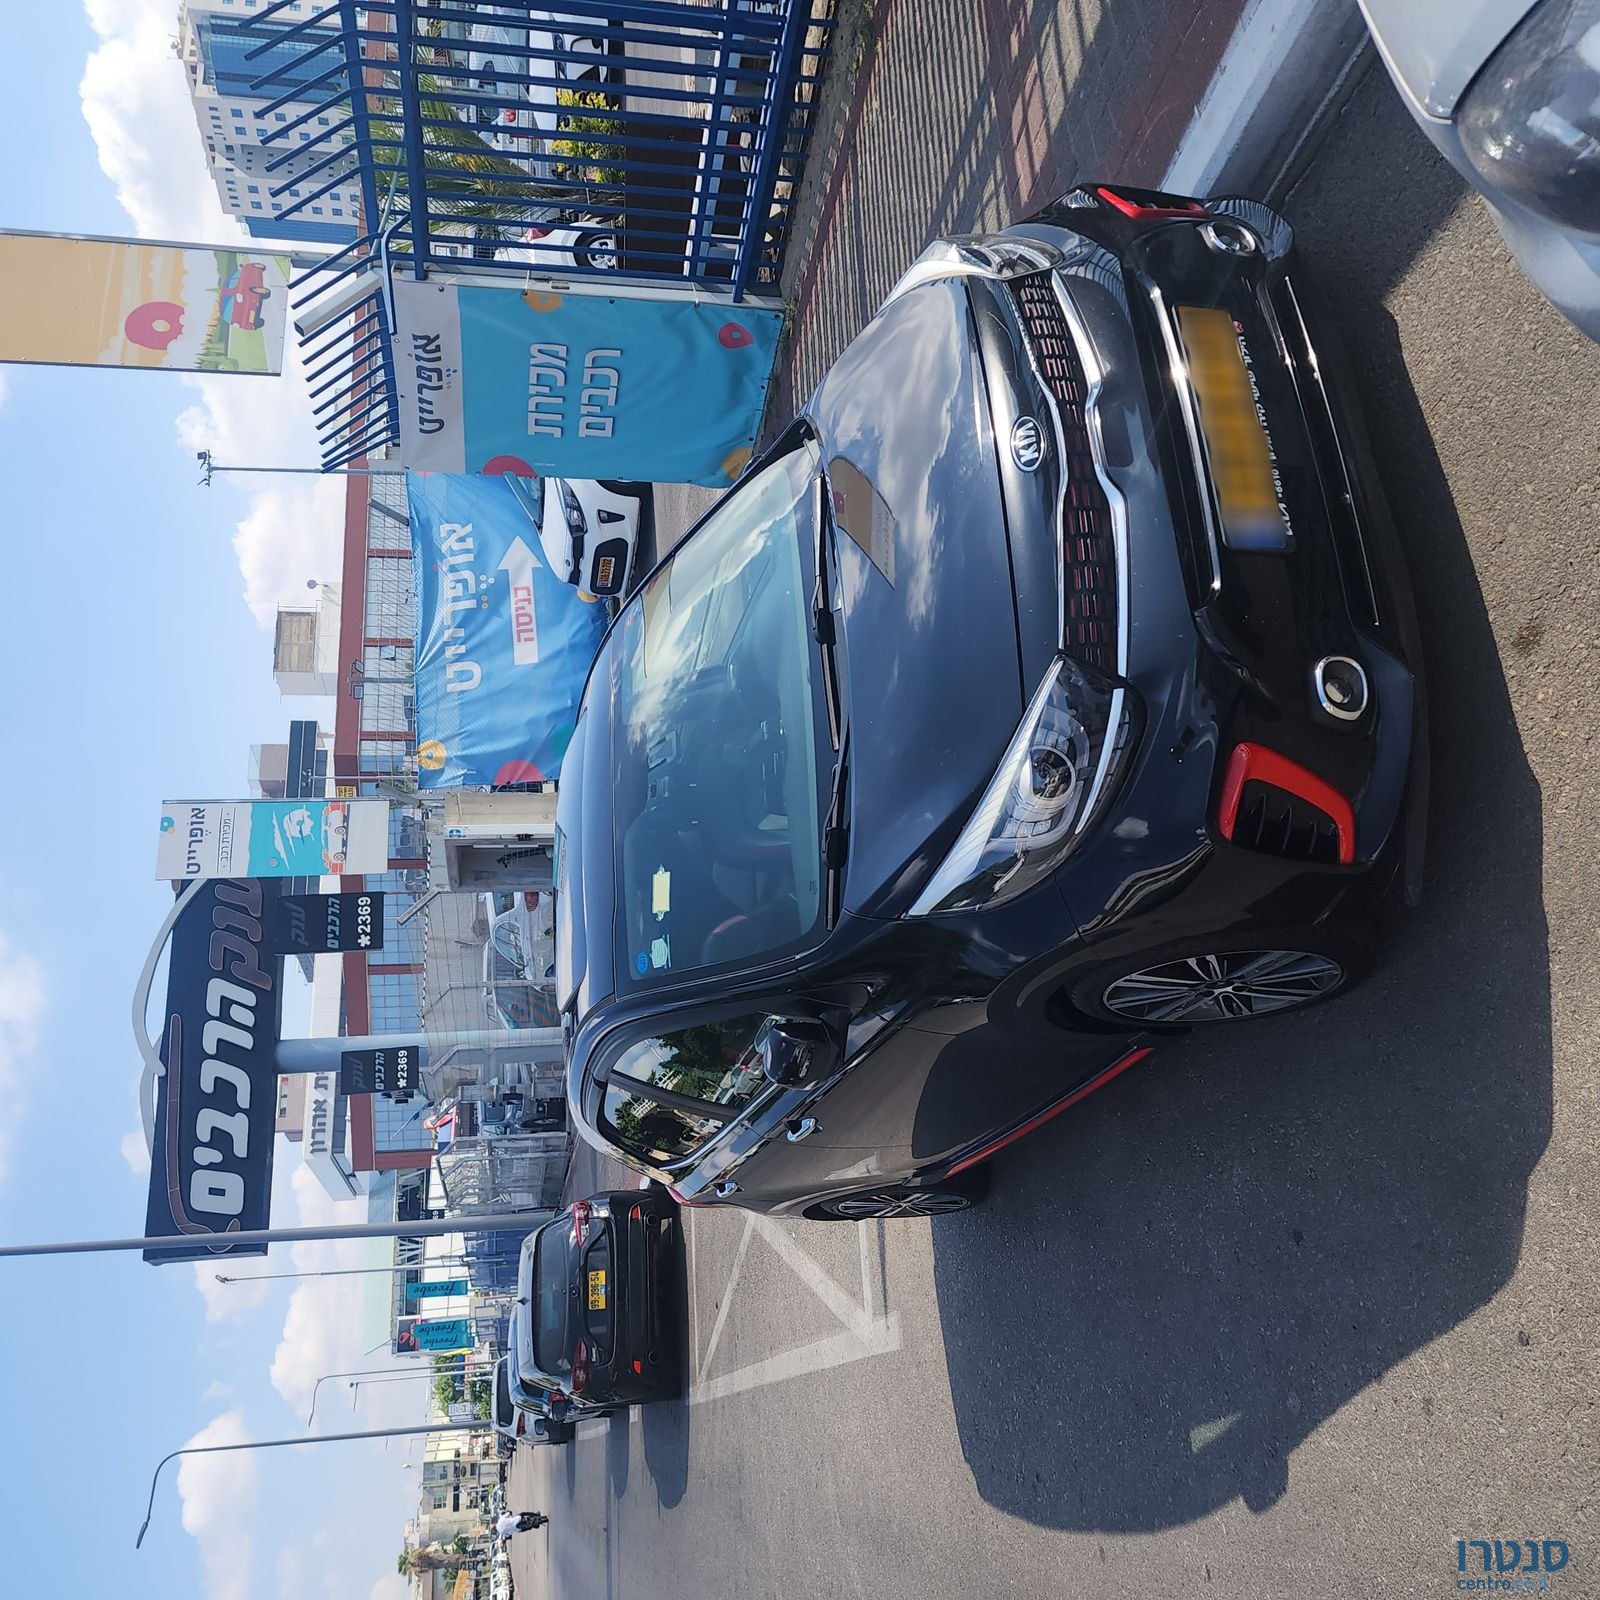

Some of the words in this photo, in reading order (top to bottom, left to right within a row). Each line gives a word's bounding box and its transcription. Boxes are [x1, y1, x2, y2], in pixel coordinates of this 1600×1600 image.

[528, 343, 568, 438] מכירת
[578, 349, 621, 438] רכבים
[1016, 422, 1039, 464] KIA
[513, 585, 534, 642] כניסה
[220, 846, 230, 862] רכב
[222, 818, 232, 844] מכירת
[284, 901, 308, 946] ענק
[327, 897, 340, 948] הרכבים
[189, 977, 256, 1215] הרכבים
[375, 1052, 385, 1090] הרכבים
[310, 1099, 328, 1154] אהרון
